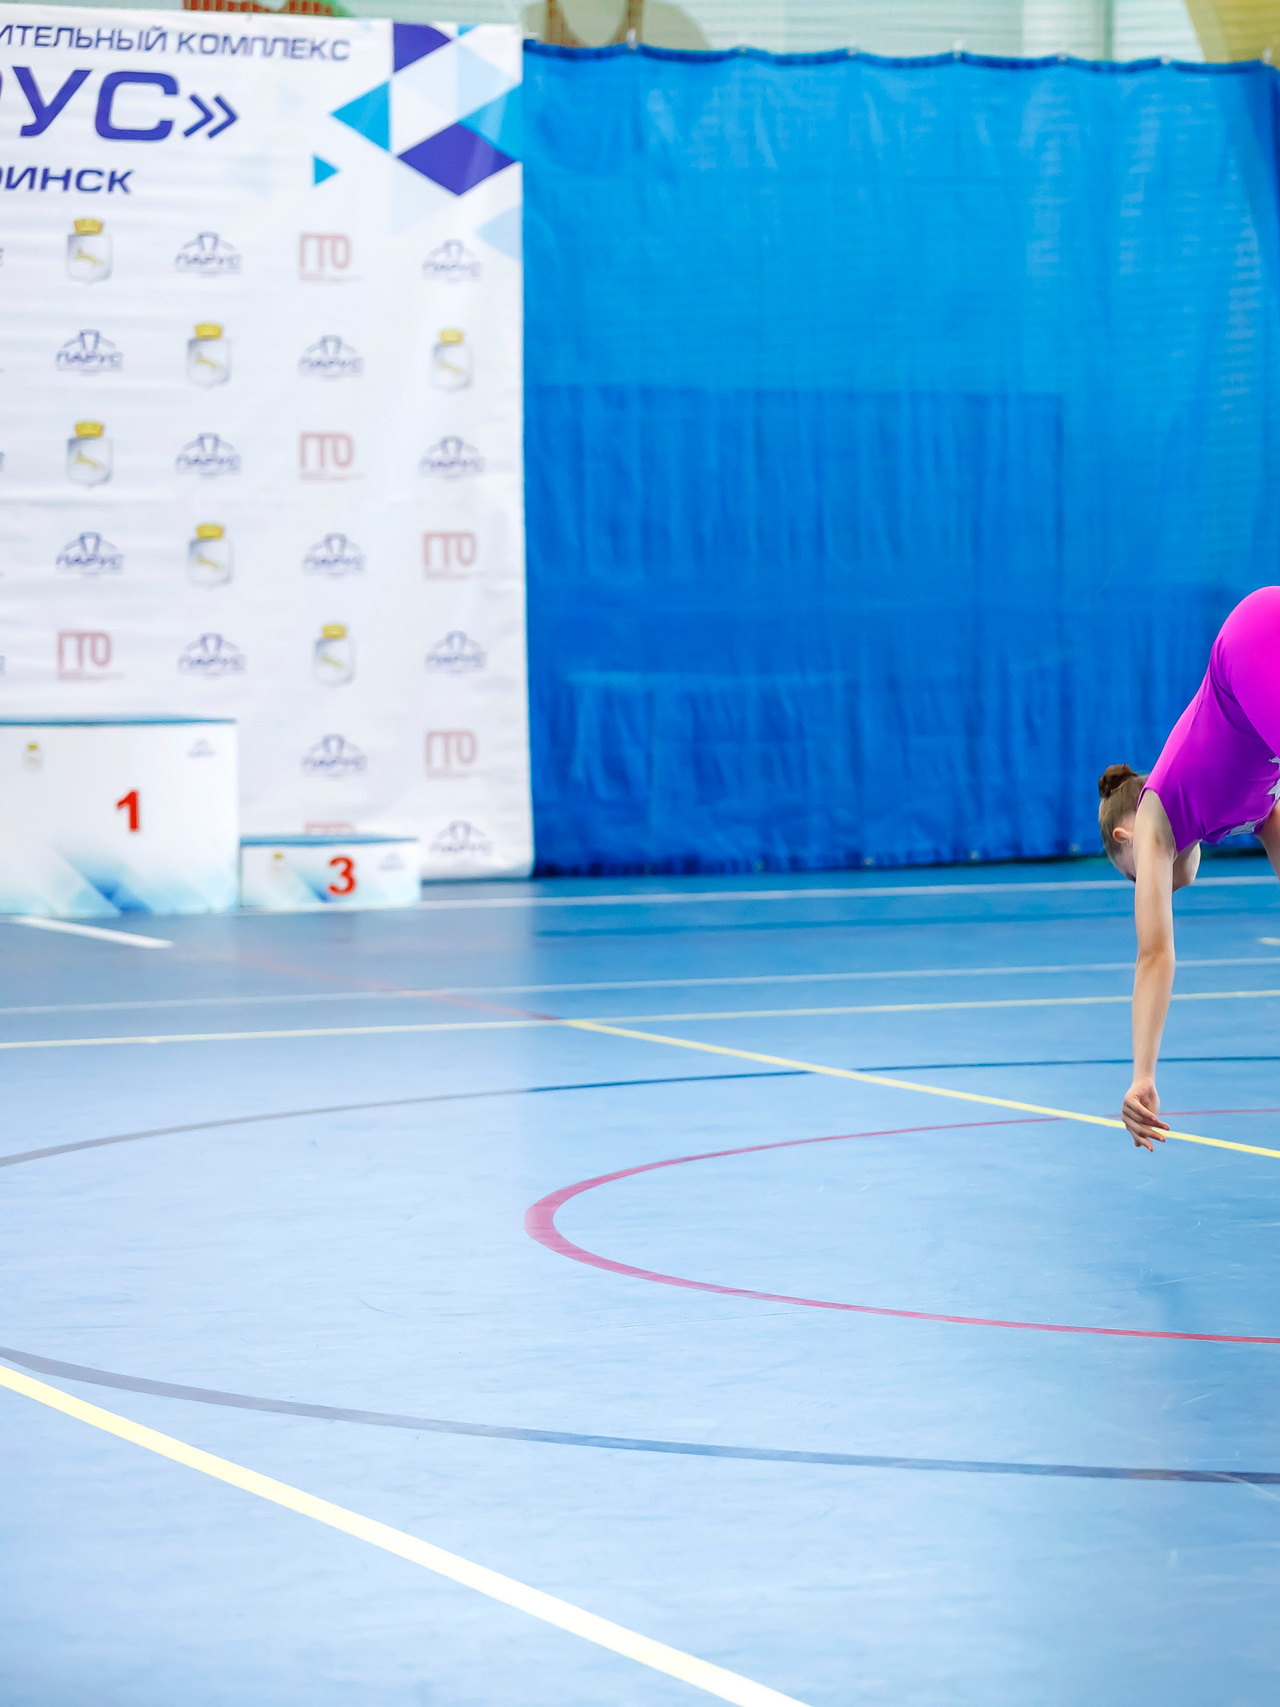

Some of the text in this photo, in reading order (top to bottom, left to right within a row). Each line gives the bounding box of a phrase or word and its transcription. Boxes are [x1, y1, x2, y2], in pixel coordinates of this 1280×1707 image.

[177, 32, 352, 61] КОМПЛЕКС
[0, 66, 239, 141] УС»
[0, 166, 134, 194] ИНСК
[116, 789, 140, 832] 1
[327, 856, 356, 896] 3
